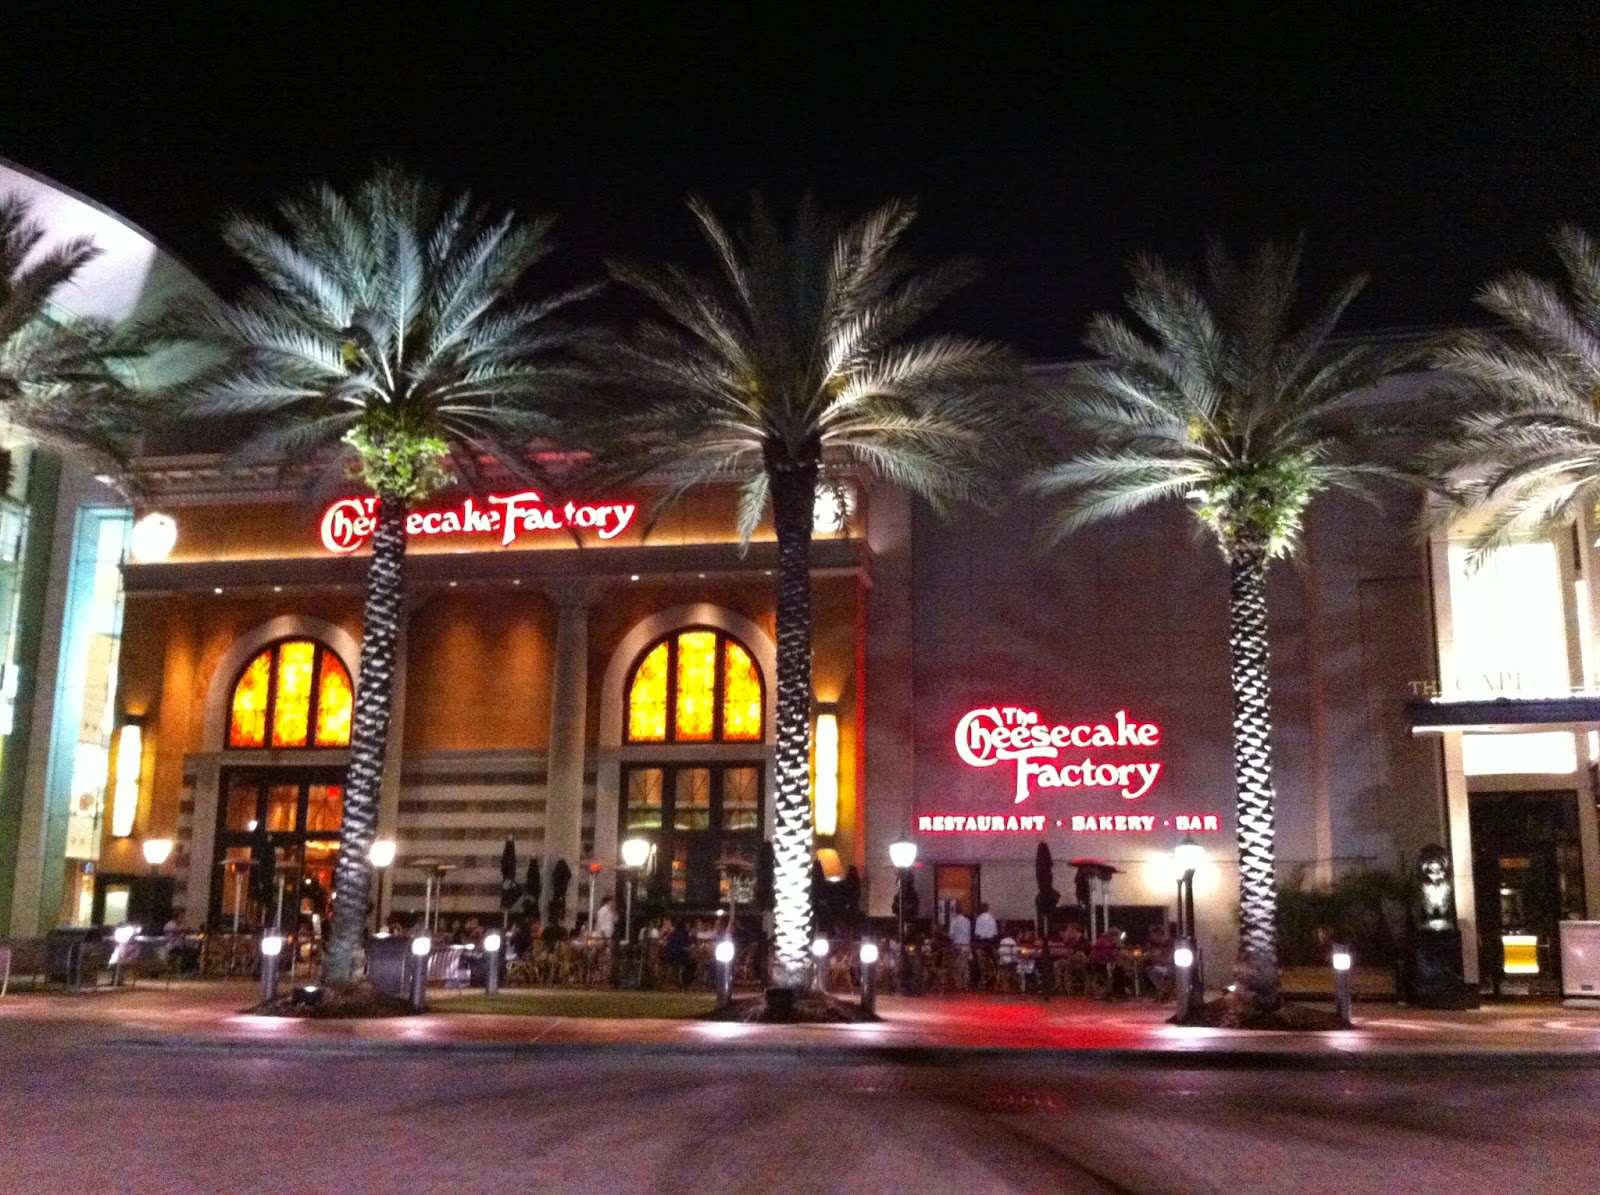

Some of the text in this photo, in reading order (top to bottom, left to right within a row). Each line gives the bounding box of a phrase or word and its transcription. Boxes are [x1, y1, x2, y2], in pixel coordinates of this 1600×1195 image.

[320, 497, 501, 553] Cheecake
[954, 706, 1160, 768] Cheesecake
[1001, 707, 1038, 727] The
[995, 746, 1161, 804] Factory
[918, 815, 1218, 832] RESTAURANT BAKERY BAR
